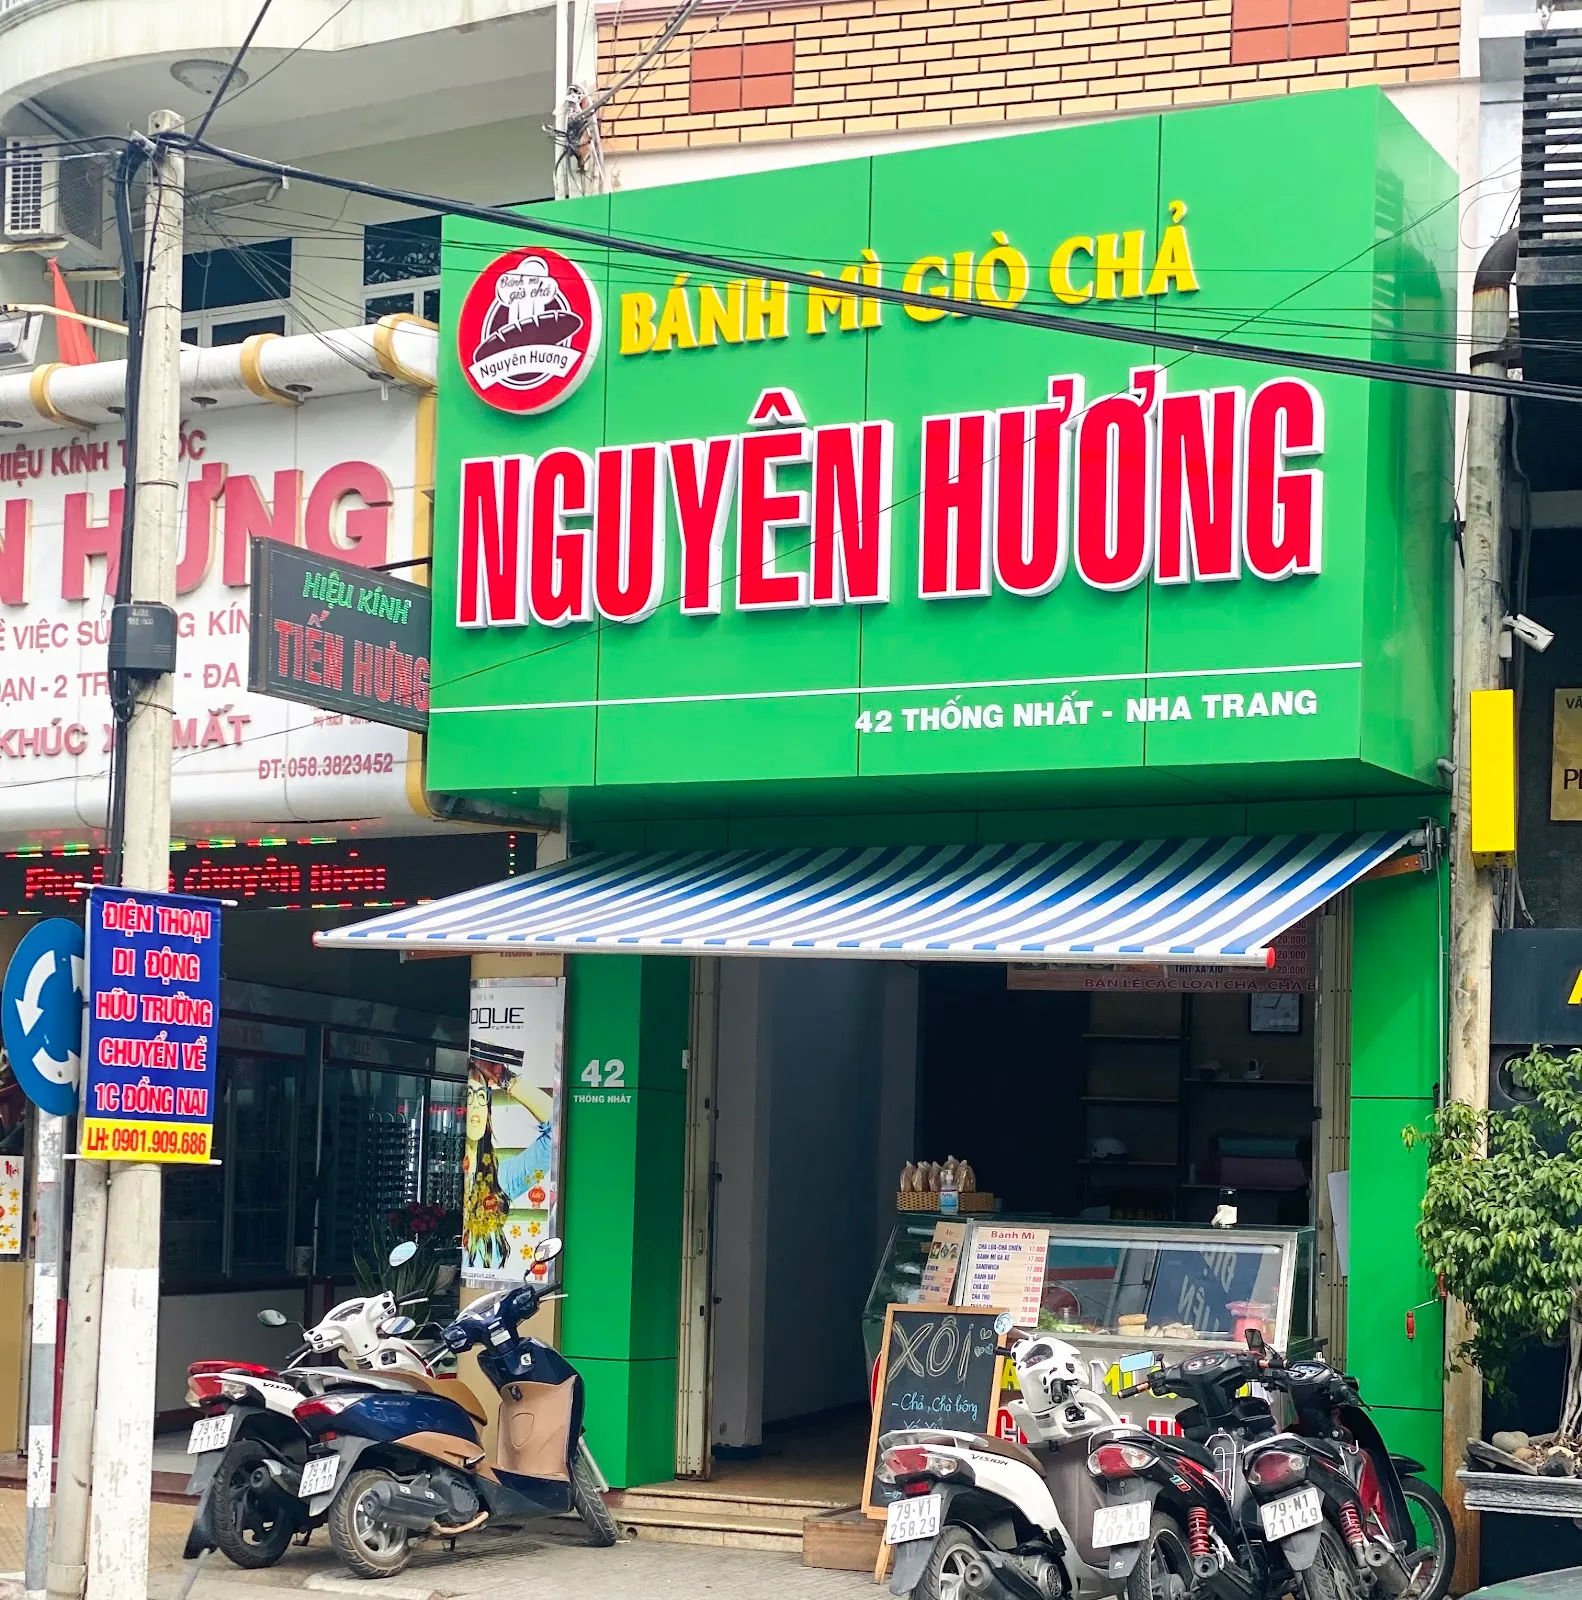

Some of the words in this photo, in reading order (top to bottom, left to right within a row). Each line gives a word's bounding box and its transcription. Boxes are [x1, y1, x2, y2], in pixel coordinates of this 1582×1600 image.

[620, 273, 790, 356] BÁNH
[806, 249, 883, 335] MÌ
[902, 231, 1031, 323] GIÒ
[1049, 200, 1200, 306] CHẢ
[479, 352, 528, 379] Nguyên
[529, 350, 569, 369] Hương
[51, 436, 110, 477] KÍNH
[456, 387, 894, 629] NGUYÊN
[918, 364, 1326, 600] HƯƠNG
[303, 570, 355, 610] HIỆU
[356, 586, 412, 625] KÍNH
[13, 618, 69, 654] VIỆC
[273, 609, 345, 692] TIẾN
[352, 640, 431, 712] HƯNG
[53, 674, 67, 699] 2
[203, 662, 241, 689] ĐA
[854, 709, 893, 734] 42
[901, 695, 1004, 732] THỐNG
[1013, 690, 1094, 728] NHẤT
[1126, 697, 1192, 723] NHA
[1202, 690, 1318, 719] TRANG
[0, 717, 88, 758] KHÚC
[172, 704, 252, 750] MẮT
[103, 898, 153, 937] ĐIỆN
[156, 906, 212, 943] THOẠI
[112, 947, 136, 977] DI
[145, 946, 200, 985] ĐỘNG
[1276, 950, 1306, 960] 20.000
[1276, 965, 1306, 975] 20.000
[96, 987, 137, 1021] HỮU
[99, 1030, 179, 1070] CHUYỂN
[182, 1035, 207, 1072] VỀ
[581, 1058, 625, 1088] 42
[95, 1083, 120, 1112] 1C
[121, 1076, 174, 1115] ĐỒNG
[176, 1086, 208, 1117] NAI
[87, 1127, 110, 1151] LH:
[111, 1128, 207, 1156] 0901.909.686
[990, 1230, 1019, 1240] Bánh
[1021, 1231, 1036, 1241] Mì
[975, 1263, 1000, 1271] SANDWICH
[970, 1453, 1009, 1466] VISION
[890, 1516, 936, 1541] 258.29
